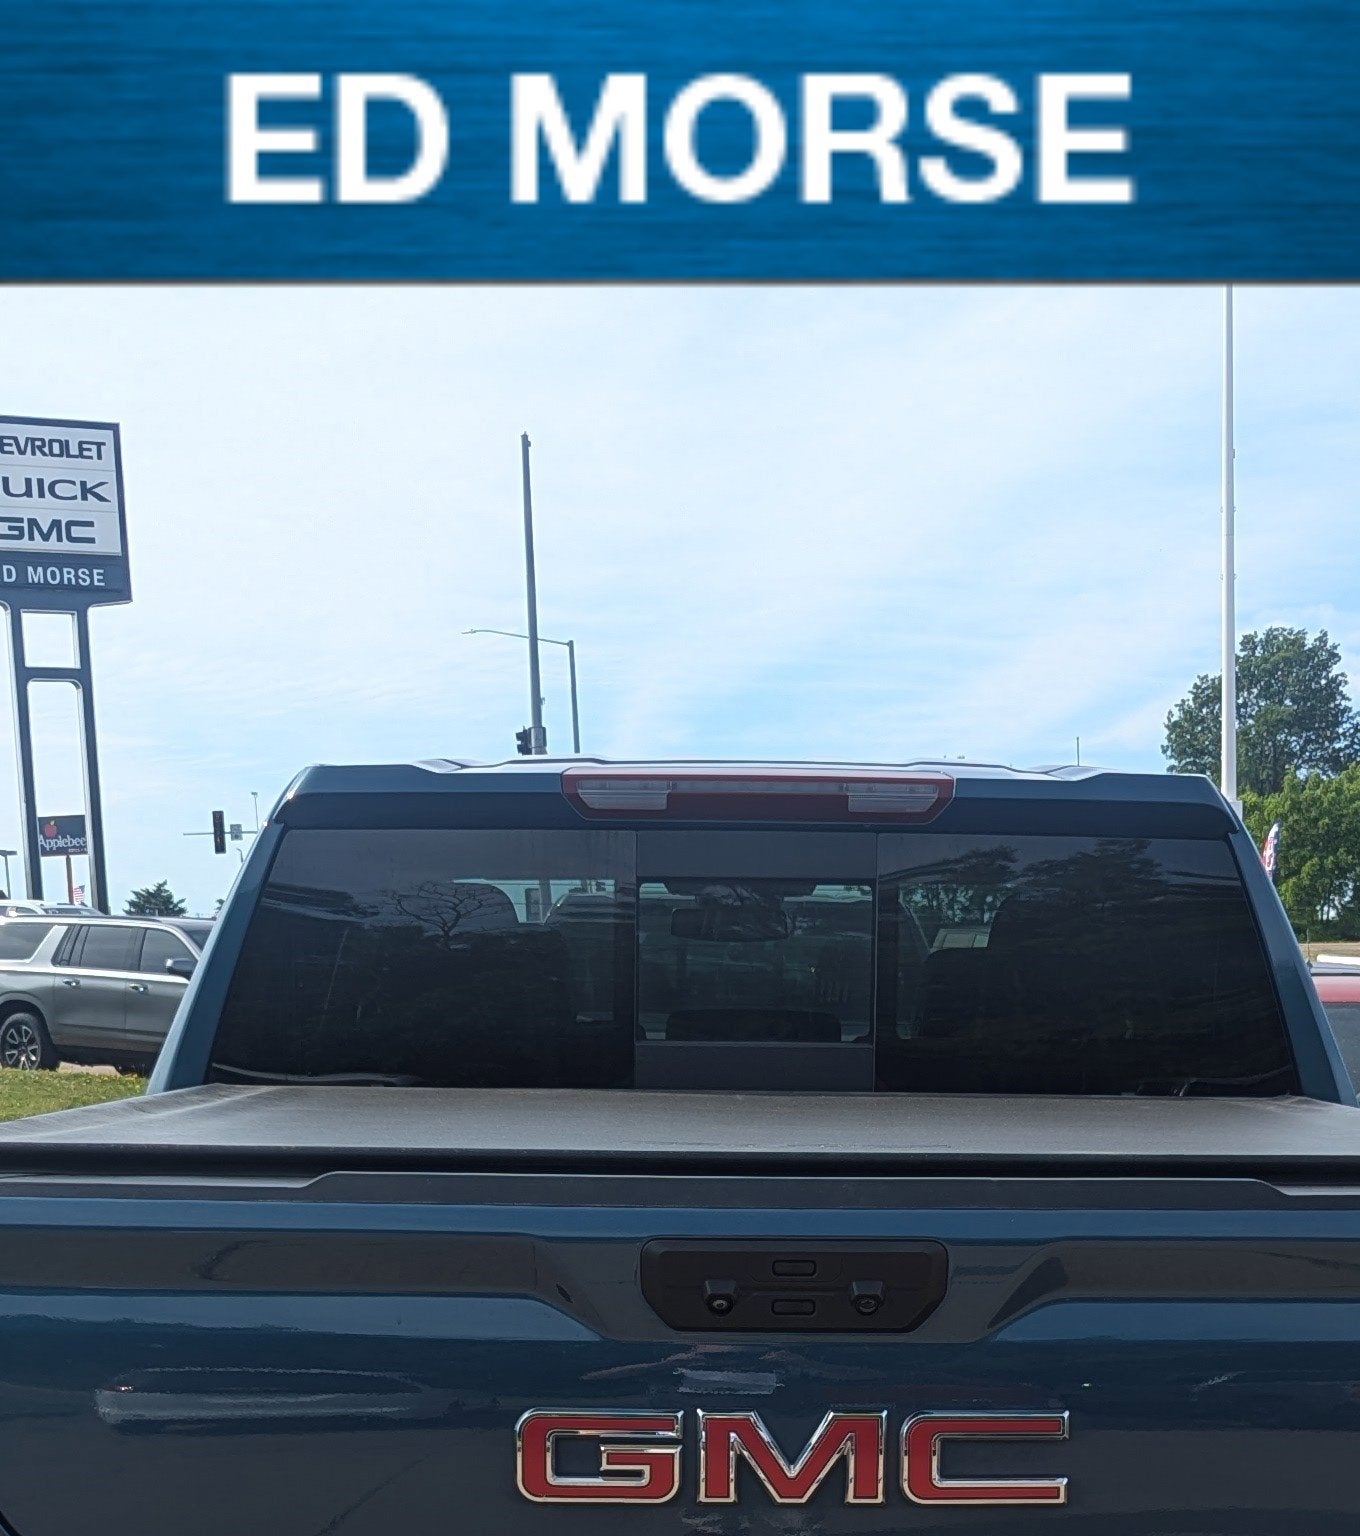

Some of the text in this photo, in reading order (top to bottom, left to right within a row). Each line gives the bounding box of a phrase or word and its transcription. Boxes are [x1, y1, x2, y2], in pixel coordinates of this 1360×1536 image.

[27, 566, 106, 586] MORSE
[40, 834, 87, 851] Applebee
[514, 1407, 1070, 1505] GMC
